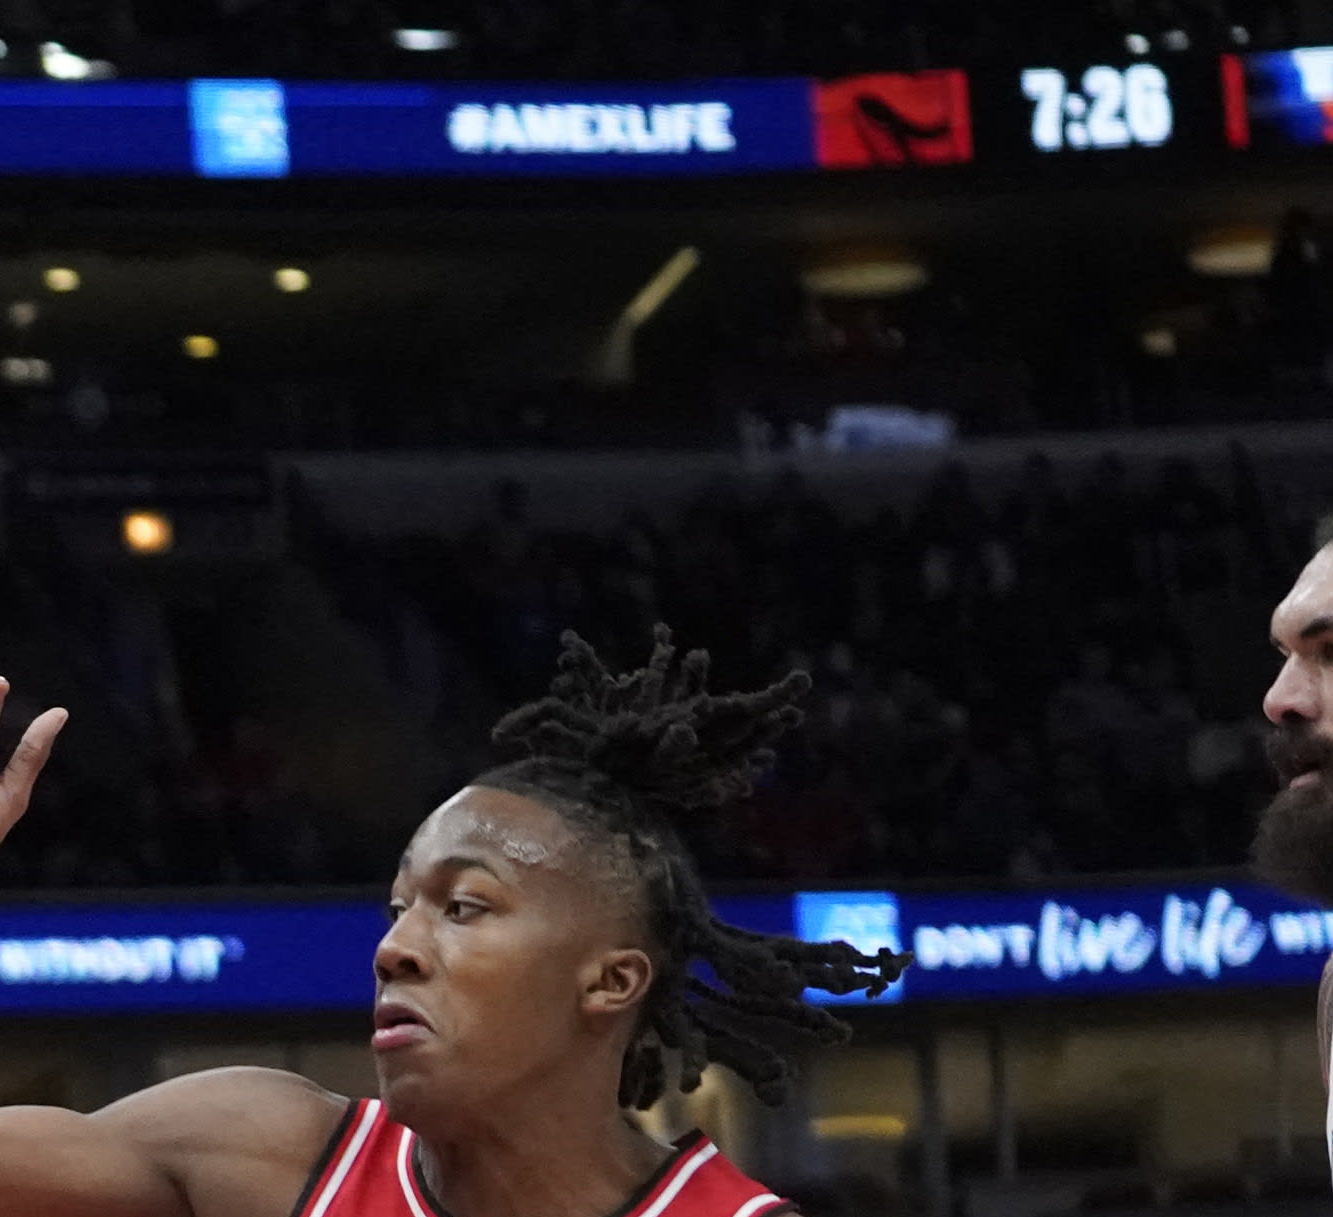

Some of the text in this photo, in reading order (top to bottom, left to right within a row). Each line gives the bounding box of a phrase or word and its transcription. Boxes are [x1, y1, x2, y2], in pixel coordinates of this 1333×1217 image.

[448, 101, 735, 153] #AMEXLIFE
[1021, 63, 1173, 152] 7:26
[1037, 899, 1158, 982] live
[1161, 886, 1268, 980] life
